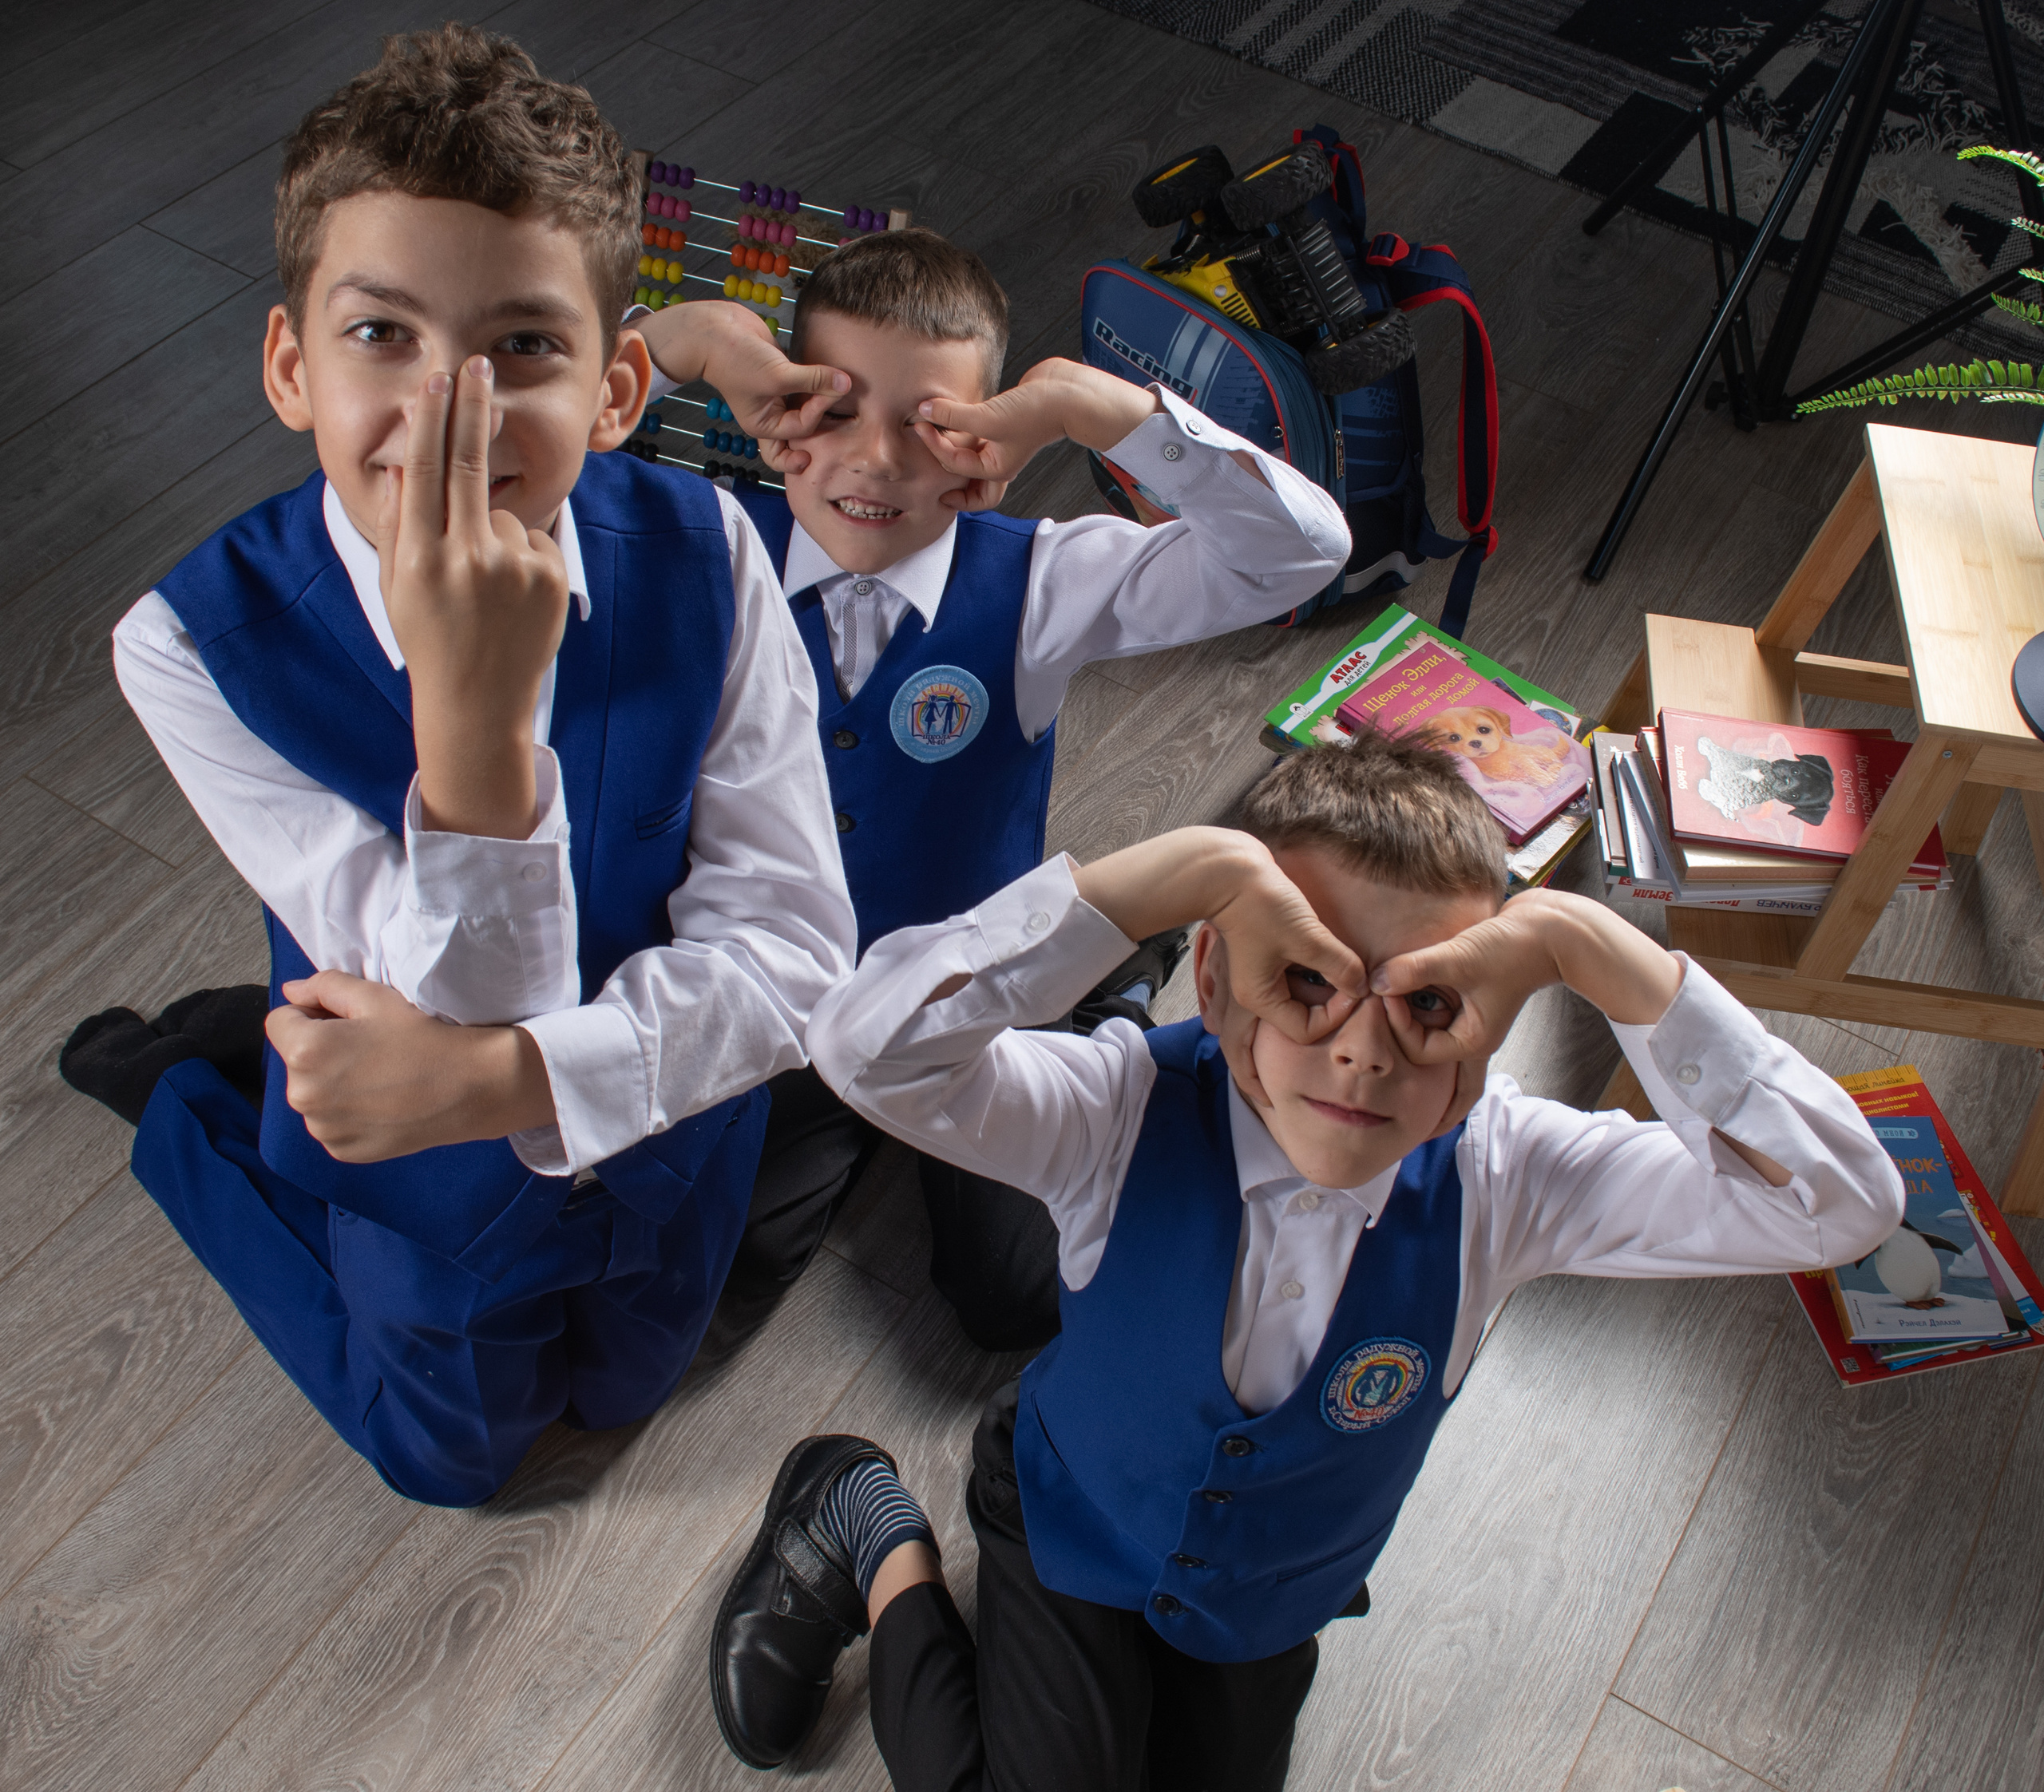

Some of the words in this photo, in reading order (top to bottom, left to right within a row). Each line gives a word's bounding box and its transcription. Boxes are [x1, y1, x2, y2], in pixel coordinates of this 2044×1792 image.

[1093, 318, 1194, 402] Racing
[1330, 651, 1367, 684] АТЛАС
[1363, 680, 1411, 712] Щенок
[1401, 655, 1447, 681] Элли,
[1410, 685, 1427, 697] или
[1428, 672, 1464, 701] дорога
[1446, 677, 1480, 704] домой
[1674, 744, 1685, 769] Холли
[1855, 754, 1870, 775] Как
[1840, 769, 1856, 814] бояться
[1632, 889, 1674, 901] Земли
[1872, 1078, 1905, 1087] линейка
[1863, 1103, 1909, 1115] циалистами
